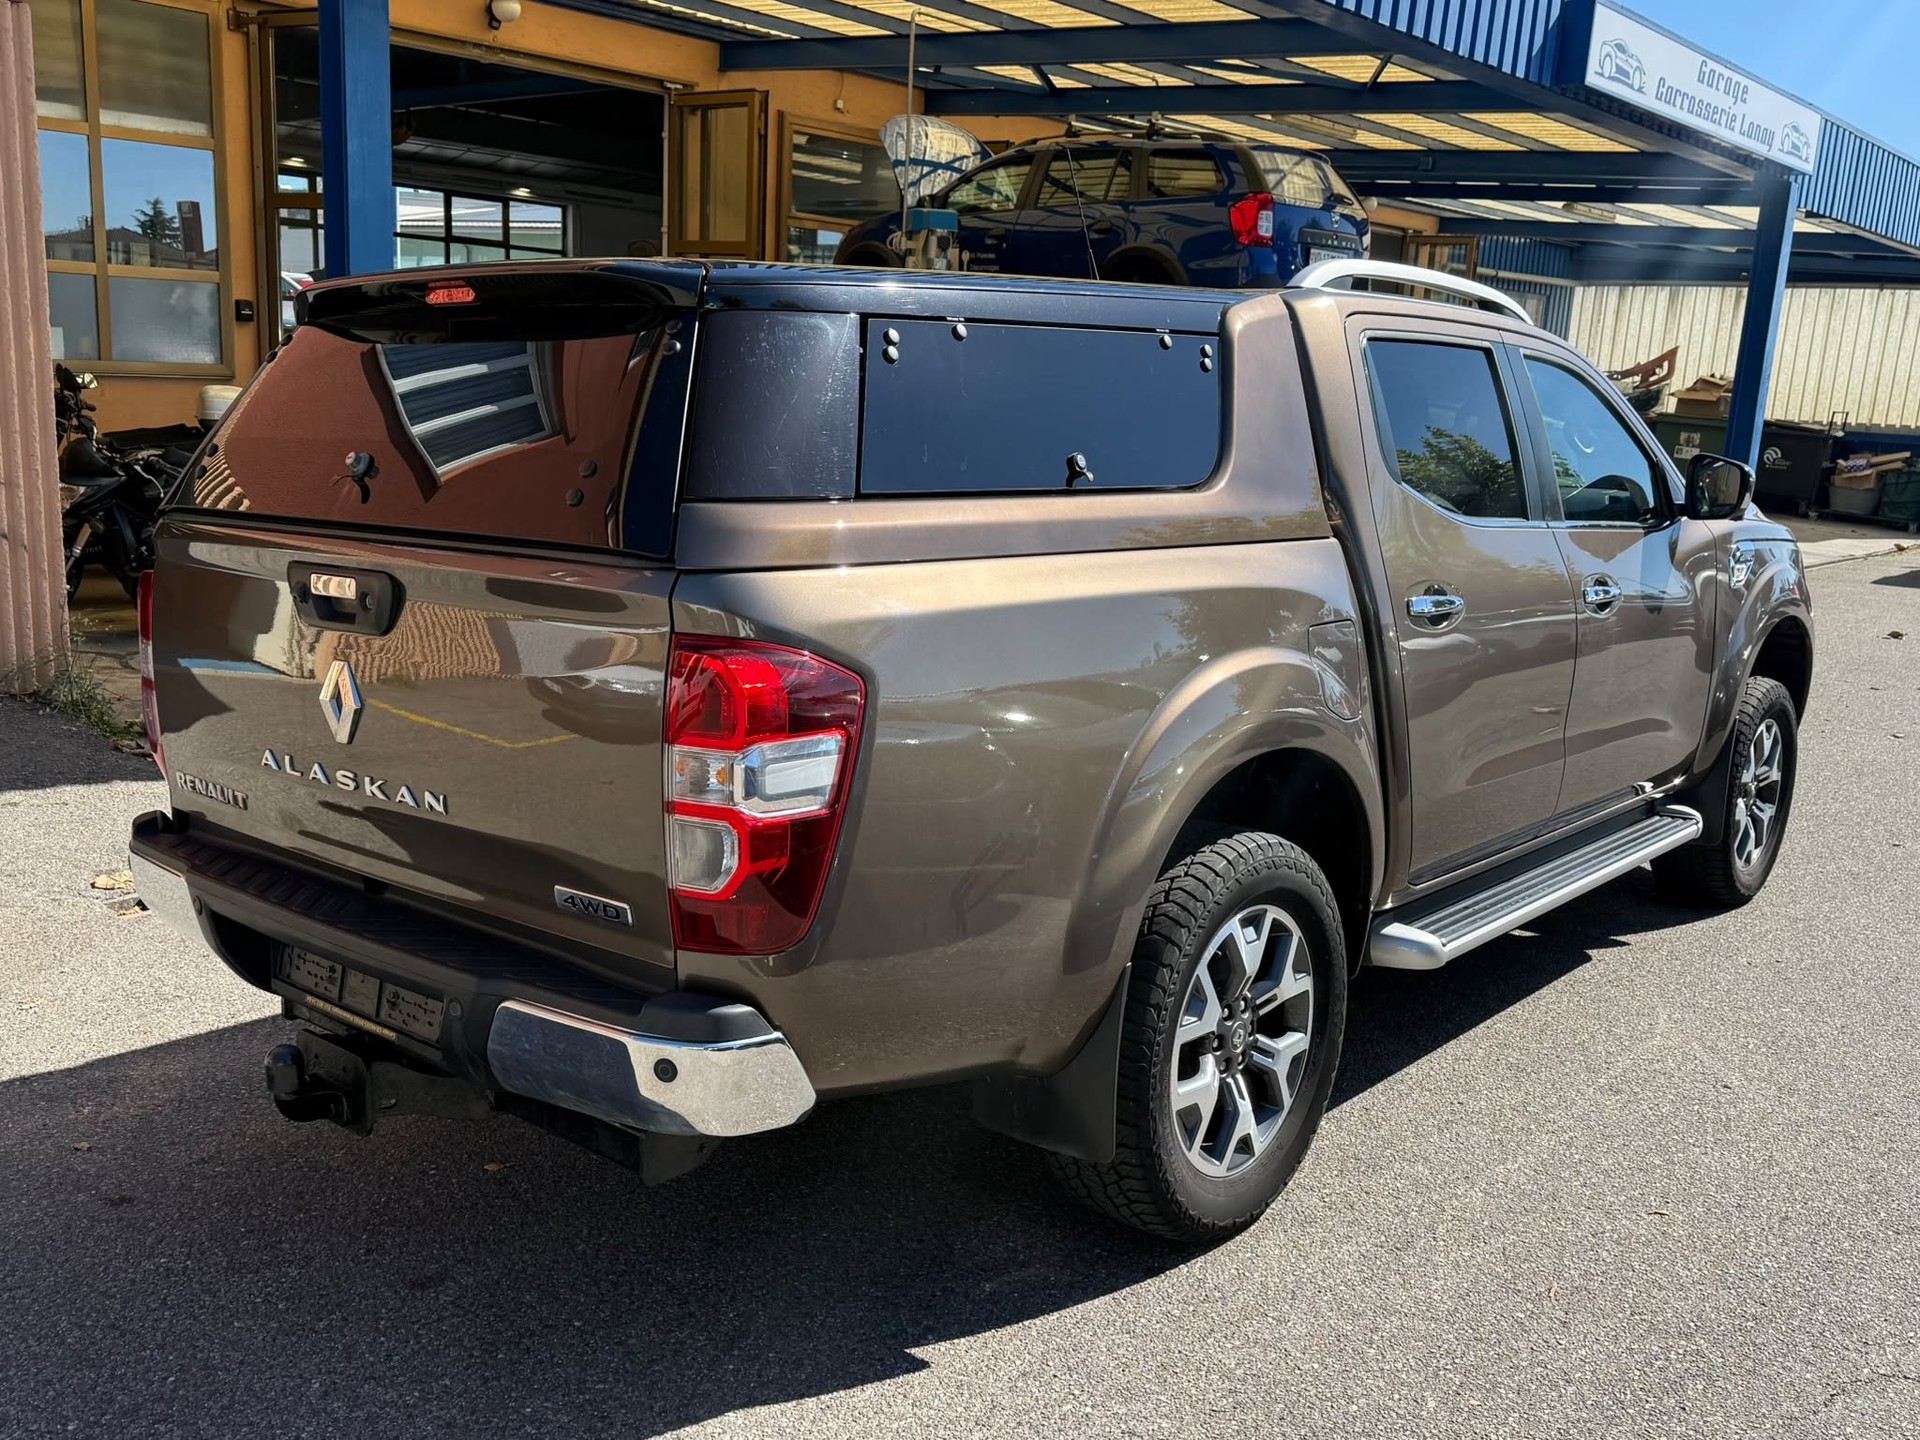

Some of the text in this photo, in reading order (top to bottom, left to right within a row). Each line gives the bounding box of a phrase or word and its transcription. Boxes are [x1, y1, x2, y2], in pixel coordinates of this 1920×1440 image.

[1697, 60, 1749, 104] Garage
[1655, 77, 1775, 152] Carrosserie Lonay
[175, 770, 248, 811] RENAULT
[261, 749, 449, 815] ALASKAN
[563, 895, 621, 921] 4WD
